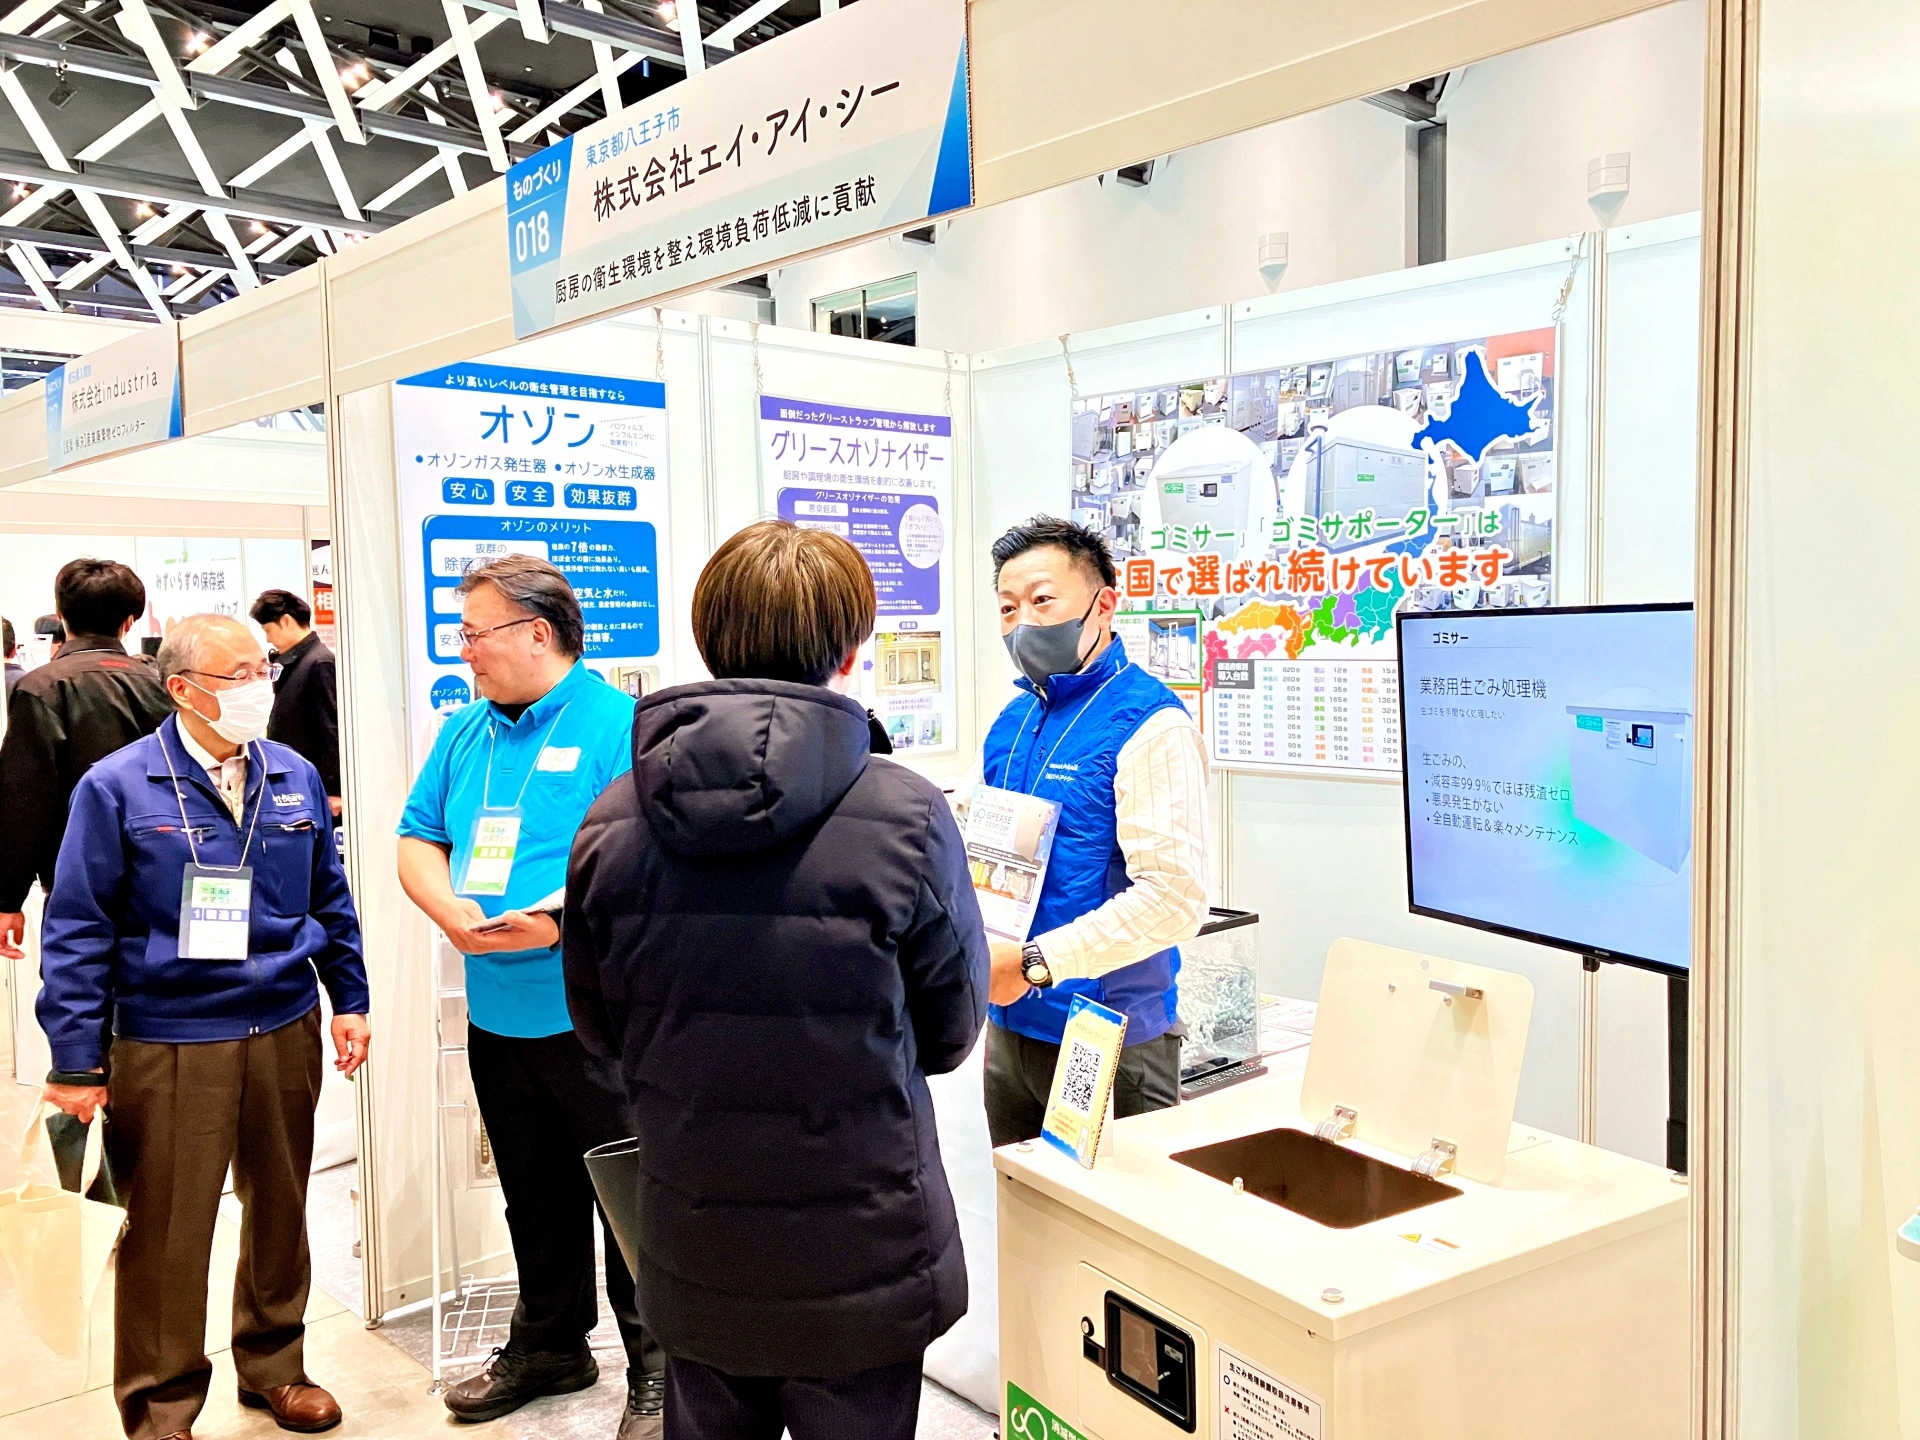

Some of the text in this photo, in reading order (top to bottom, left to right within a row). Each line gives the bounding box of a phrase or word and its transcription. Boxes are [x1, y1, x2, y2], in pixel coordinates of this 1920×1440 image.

[585, 106, 681, 170] 東京都八王子市
[593, 81, 900, 223] 株式会社エイ・アイ・シー
[512, 158, 562, 202] ものづくり
[515, 210, 550, 262] 018
[555, 174, 877, 305] 厨房の衛生環境を整え環境負荷低減に貢献
[71, 366, 158, 415] 株式会社industria
[445, 374, 625, 401] より高いレベルの衛生管理を目指すなら
[480, 404, 595, 448] オゾン
[779, 408, 936, 433] 面倒だったグリーストラップ管理から解放します
[771, 430, 944, 471] グリースオゾナイザー
[427, 452, 656, 481] オゾンガス発生器 オゾン水生成器
[450, 482, 631, 507] 安心 安全 効果抜群
[815, 490, 901, 504] グリースオゾナイザーの効果
[500, 520, 592, 535] オゾンのメリット
[475, 543, 507, 554] 抜群の
[156, 570, 226, 592] みずいらずの保存袋
[1115, 548, 1510, 599] 国で選ばれ続けています
[1432, 631, 1469, 645] ゴミサー
[432, 689, 469, 697] オゾンガス
[1420, 675, 1548, 700] 業務用生ごみ処理機
[1420, 706, 1506, 720] 生ゴミを手間なく処理したい
[1422, 753, 1468, 770] 生ごみの、
[1431, 773, 1571, 802] 減容率99.9%でほぼ残渣ゼロ
[1432, 792, 1505, 813] 悪臭発生がない
